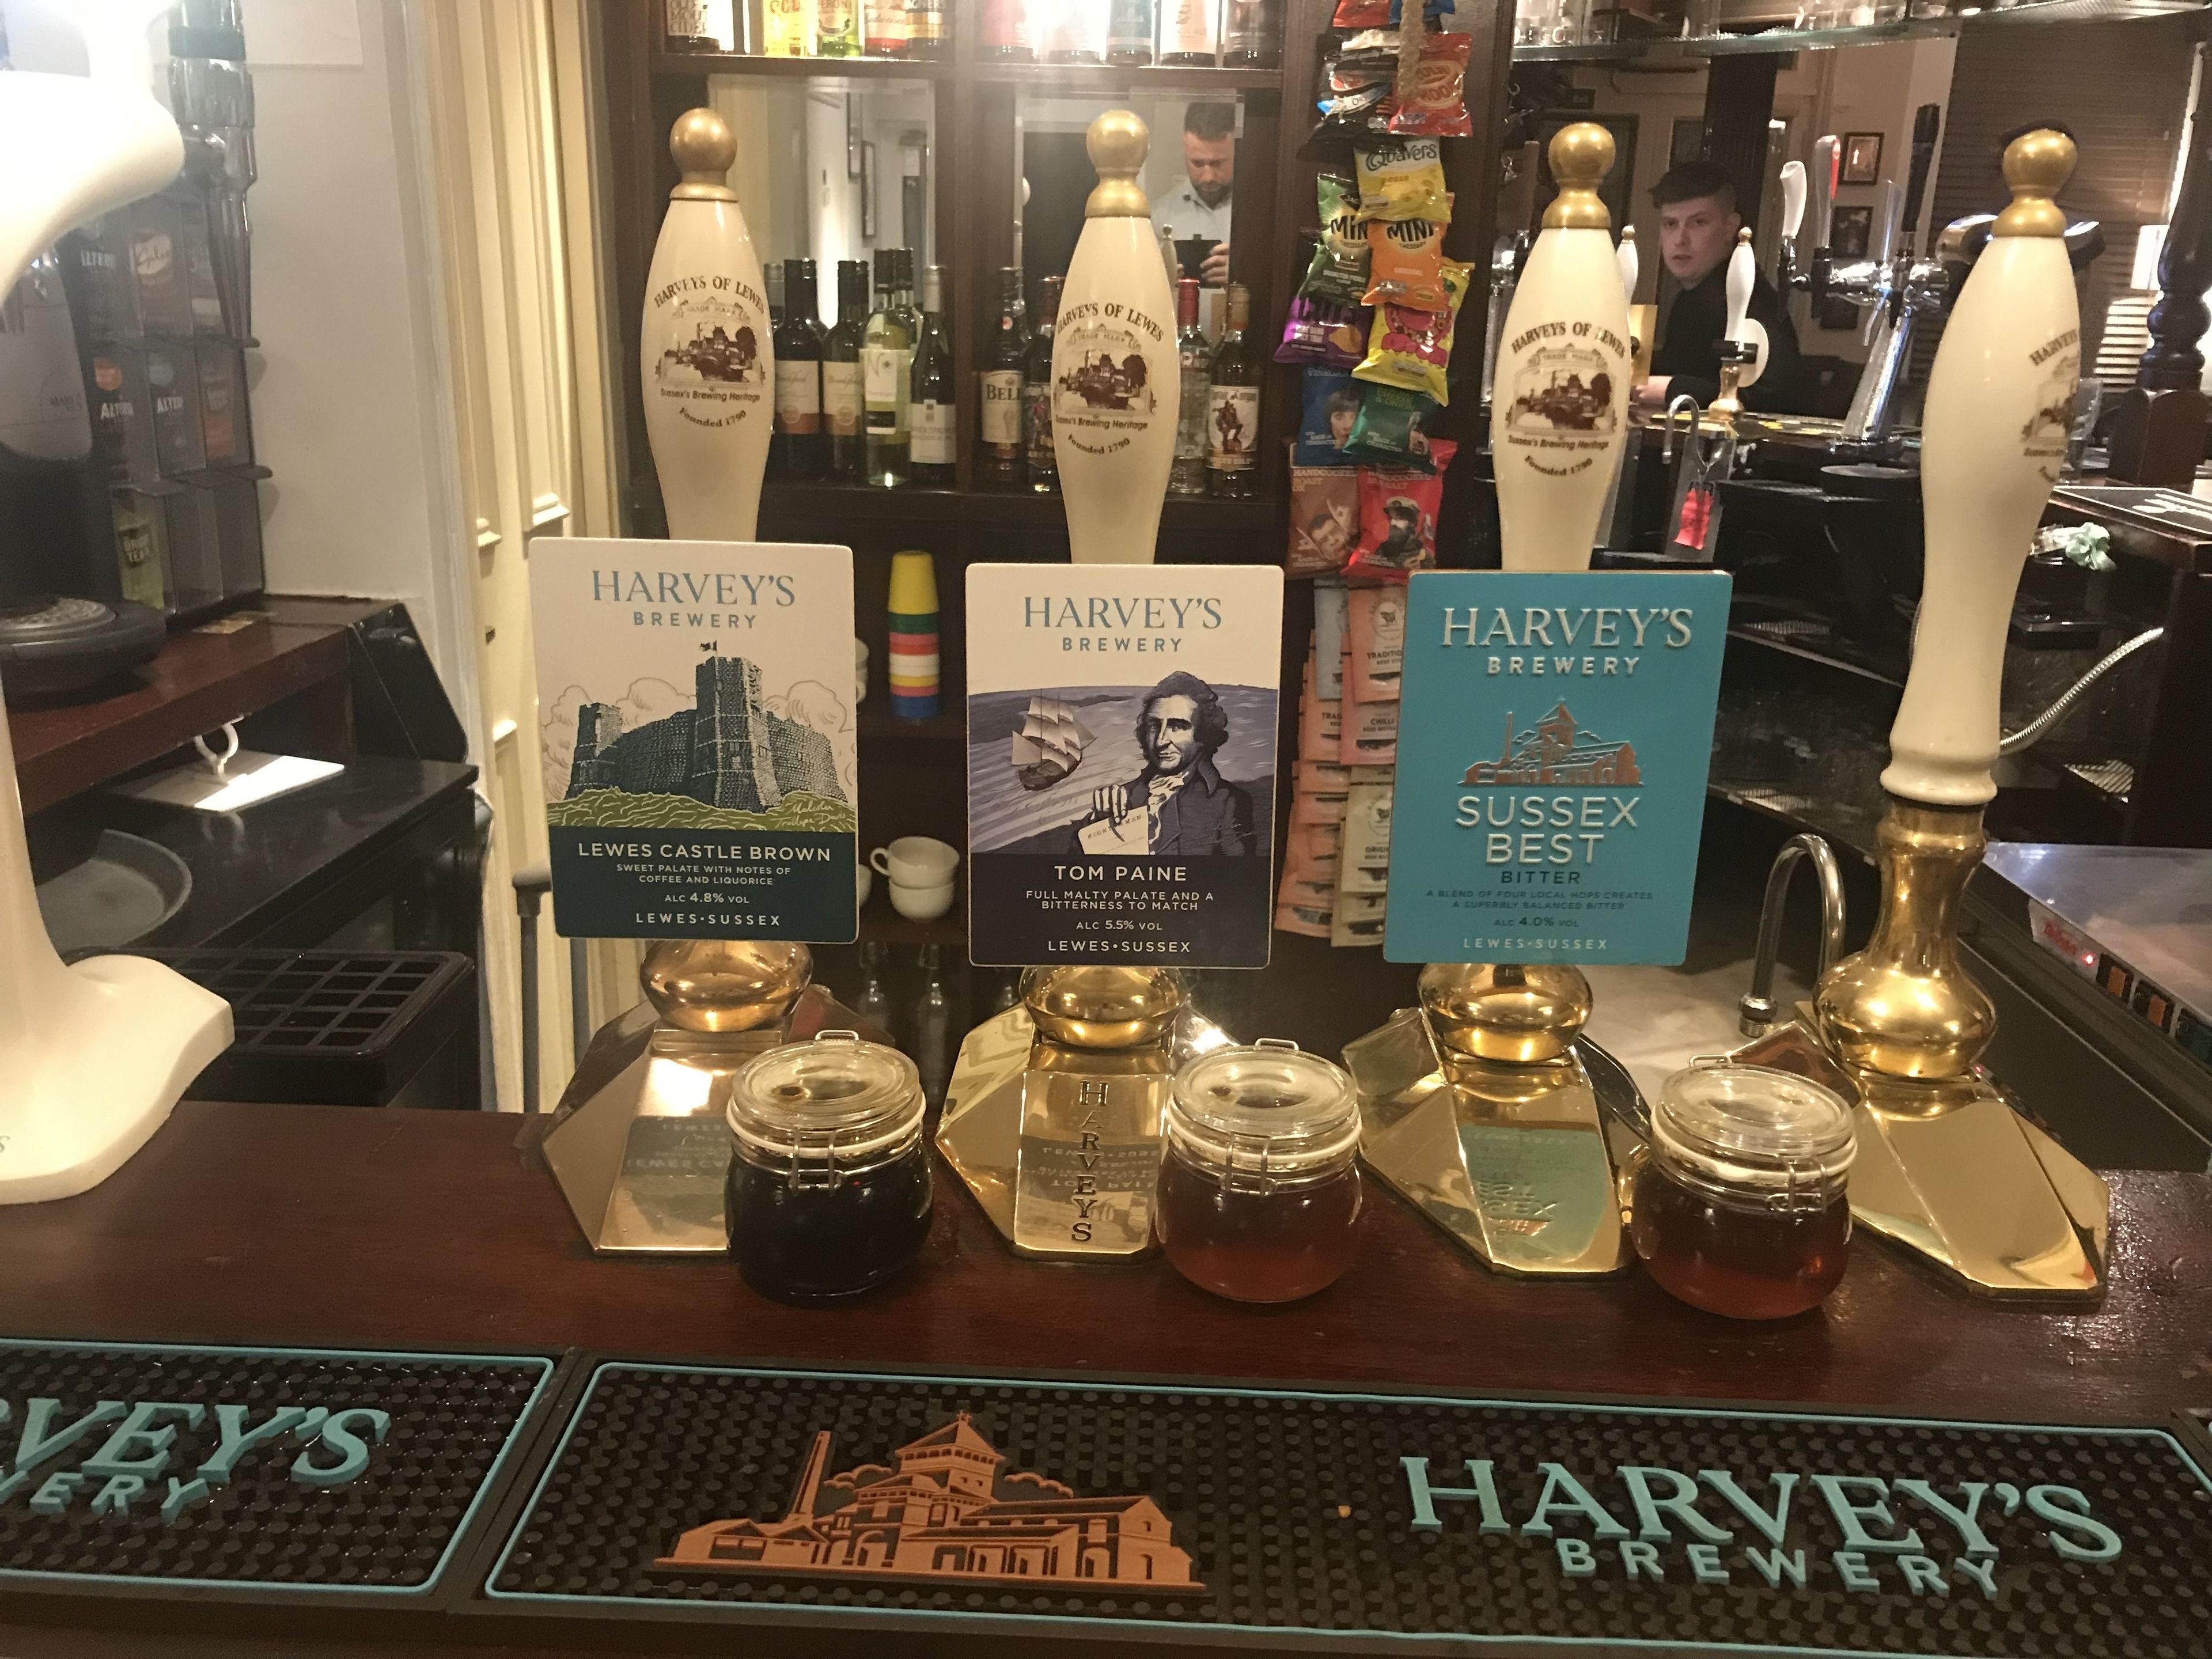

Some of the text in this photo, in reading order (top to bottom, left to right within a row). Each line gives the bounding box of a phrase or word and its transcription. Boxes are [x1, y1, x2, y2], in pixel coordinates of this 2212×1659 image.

[712, 276, 732, 290] OF
[1104, 303, 1124, 318] OF
[1127, 309, 1164, 342] LEWES
[1512, 321, 1566, 354] HARVEYS
[1573, 321, 1592, 336] OF
[692, 390, 727, 403] Brewing
[729, 392, 760, 403] Heritage
[679, 406, 747, 427] Founded 1790
[1078, 417, 1111, 430] Brewing
[1112, 420, 1148, 431] Heritage
[1067, 433, 1131, 454] Founded 1790
[1540, 439, 1575, 451] Brewing
[592, 570, 796, 607] HARVEY'S
[634, 611, 756, 629] BREWERY
[1024, 597, 1222, 629] HARVEY'S
[1441, 607, 1694, 647] HARVEY'S
[1062, 637, 1182, 653] BREWERY
[1488, 657, 1640, 675] BREWERY
[1455, 796, 1641, 828] SUSSEX
[578, 843, 831, 862] LEWES CASTLE BROWN
[1486, 833, 1605, 864] BEST
[616, 864, 791, 875] SWEET PALATE WITH NOTES OF
[1054, 865, 1187, 881] TOM PAINE
[1501, 870, 1581, 884] BITTER
[639, 875, 774, 886] COFFEE AND LIQUORICE
[665, 892, 749, 904] ALC 4.8% VOL
[1026, 890, 1214, 901] FULL MALTY PALATE AND A
[1438, 890, 1474, 898] BLEND
[1478, 891, 1493, 899] OF
[1497, 891, 1527, 899] FOUR
[1530, 892, 1566, 900] LOCAL
[1570, 892, 1600, 900] HOPS
[1604, 892, 1653, 900] CREATES
[1041, 900, 1198, 911] BITTERNESS TO MATCH
[1452, 900, 1625, 911] A SUPERBLY BALANCED BITTER
[1076, 920, 1162, 931] ALC 5.5% VOL
[1518, 915, 1555, 926] 4.0%
[0, 1397, 391, 1486] VEY'S
[1400, 1456, 2122, 1563] HARVEY'S
[1555, 1537, 2000, 1600] BREWERY
